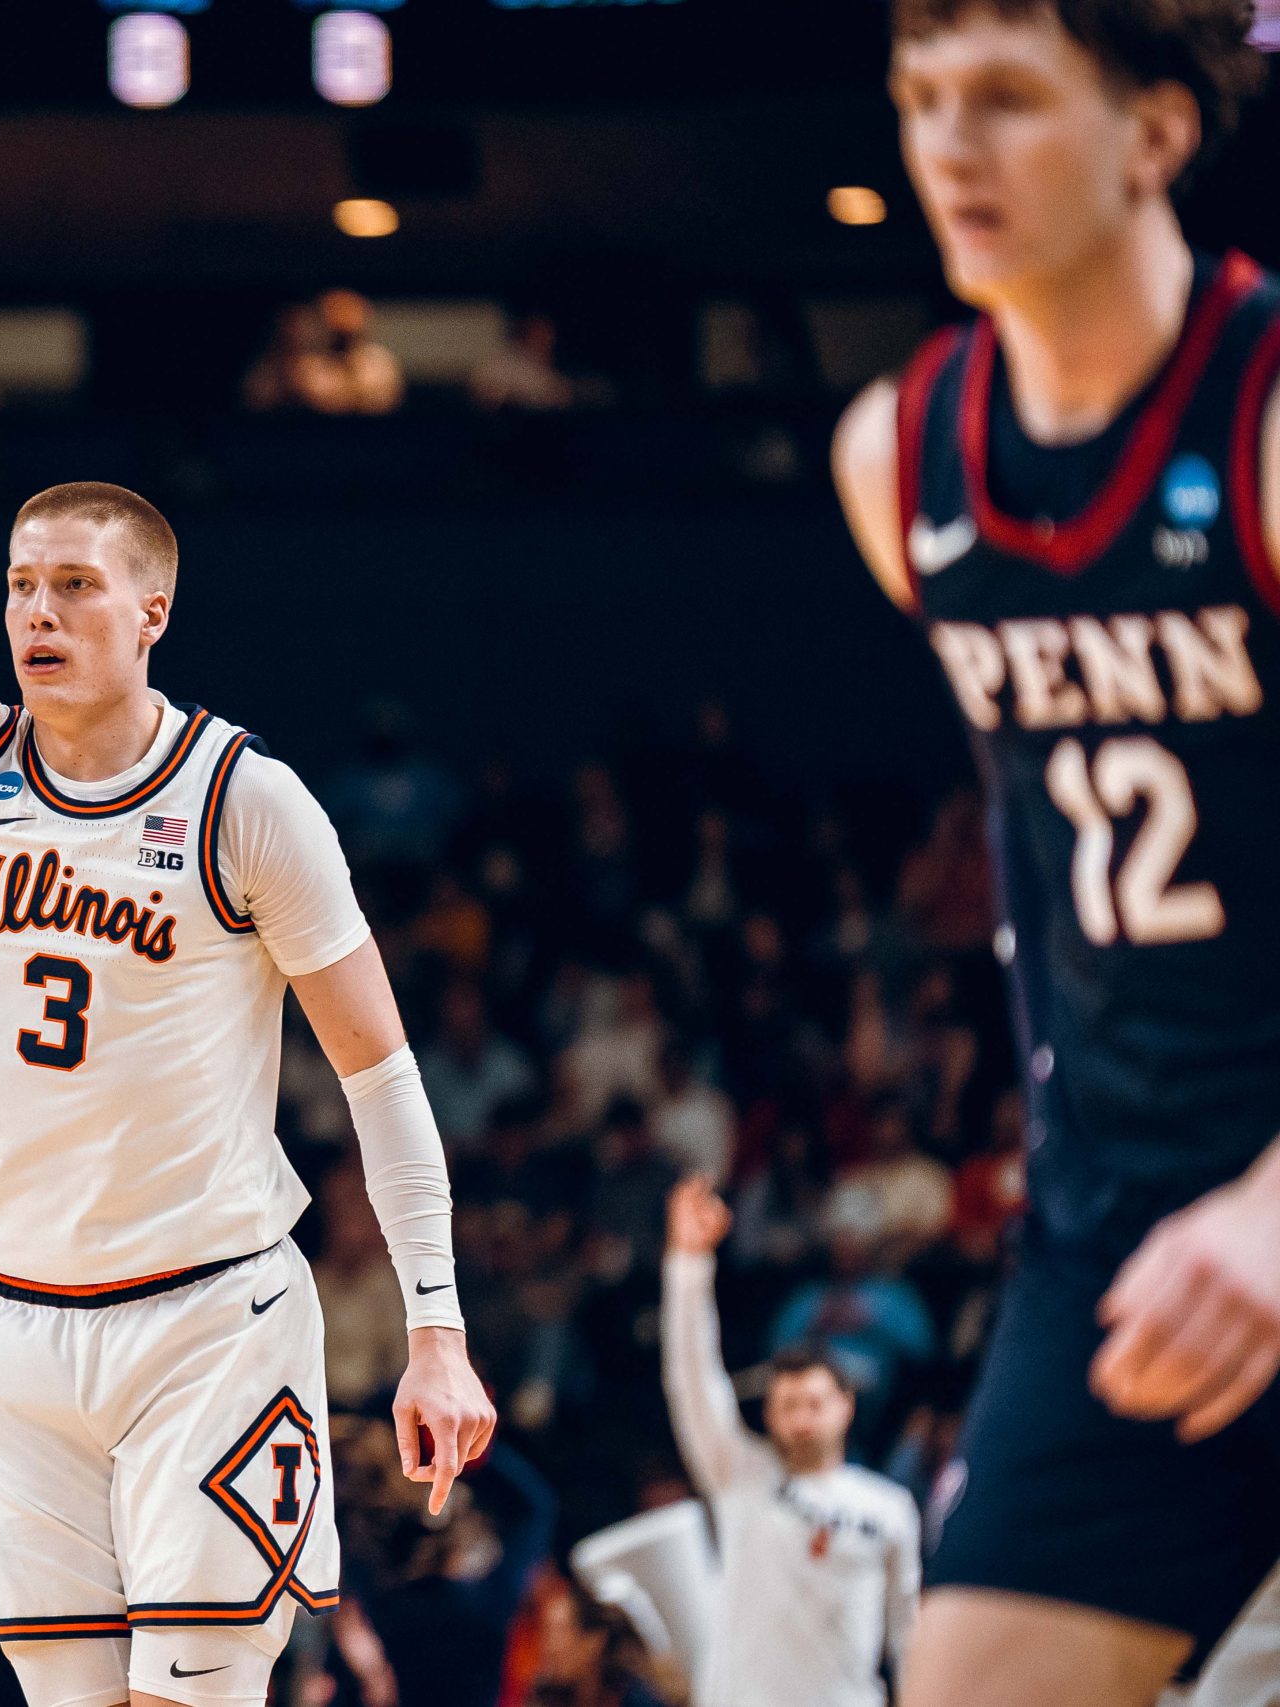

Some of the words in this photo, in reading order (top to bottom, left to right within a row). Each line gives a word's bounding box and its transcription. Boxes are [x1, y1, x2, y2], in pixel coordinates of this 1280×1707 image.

[930, 604, 1264, 732] PENN
[1044, 734, 1226, 948] 12
[16, 952, 92, 1072] 3
[271, 1443, 302, 1525] I
